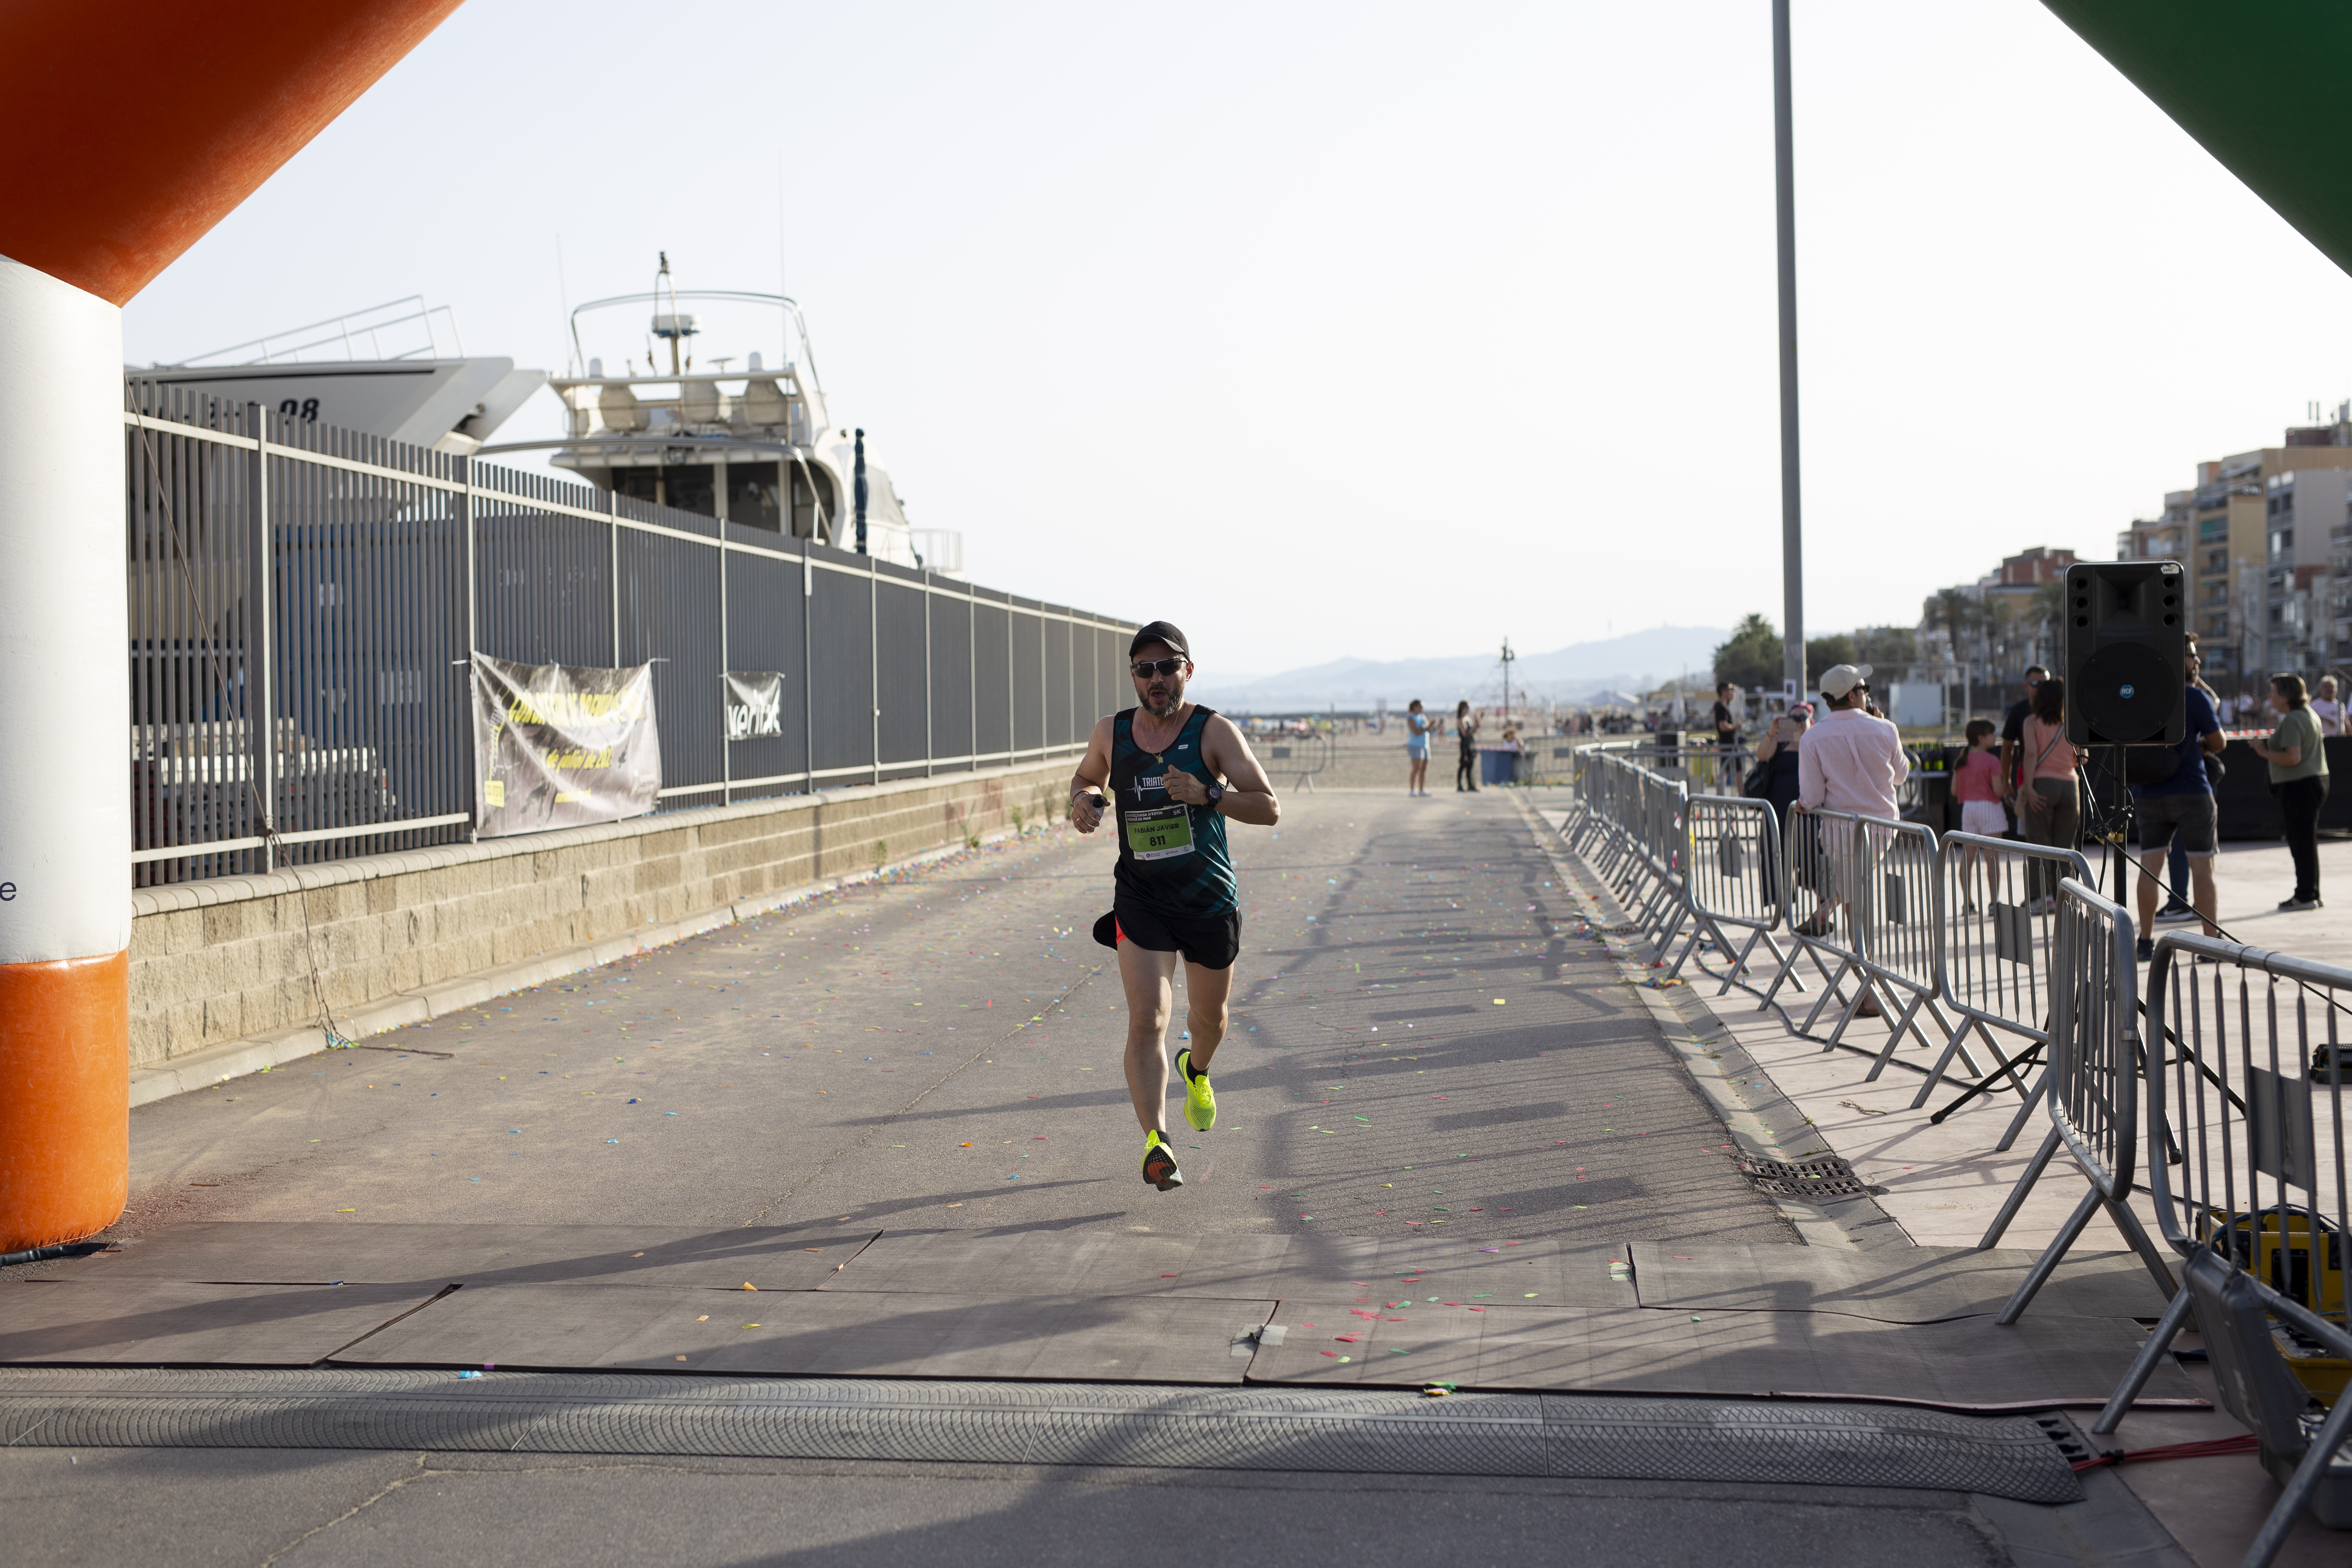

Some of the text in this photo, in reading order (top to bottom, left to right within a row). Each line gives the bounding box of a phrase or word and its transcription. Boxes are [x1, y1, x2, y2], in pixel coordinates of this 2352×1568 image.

[1134, 823, 1179, 834] FABIÁN JAVIER
[1149, 835, 1166, 846] 811
